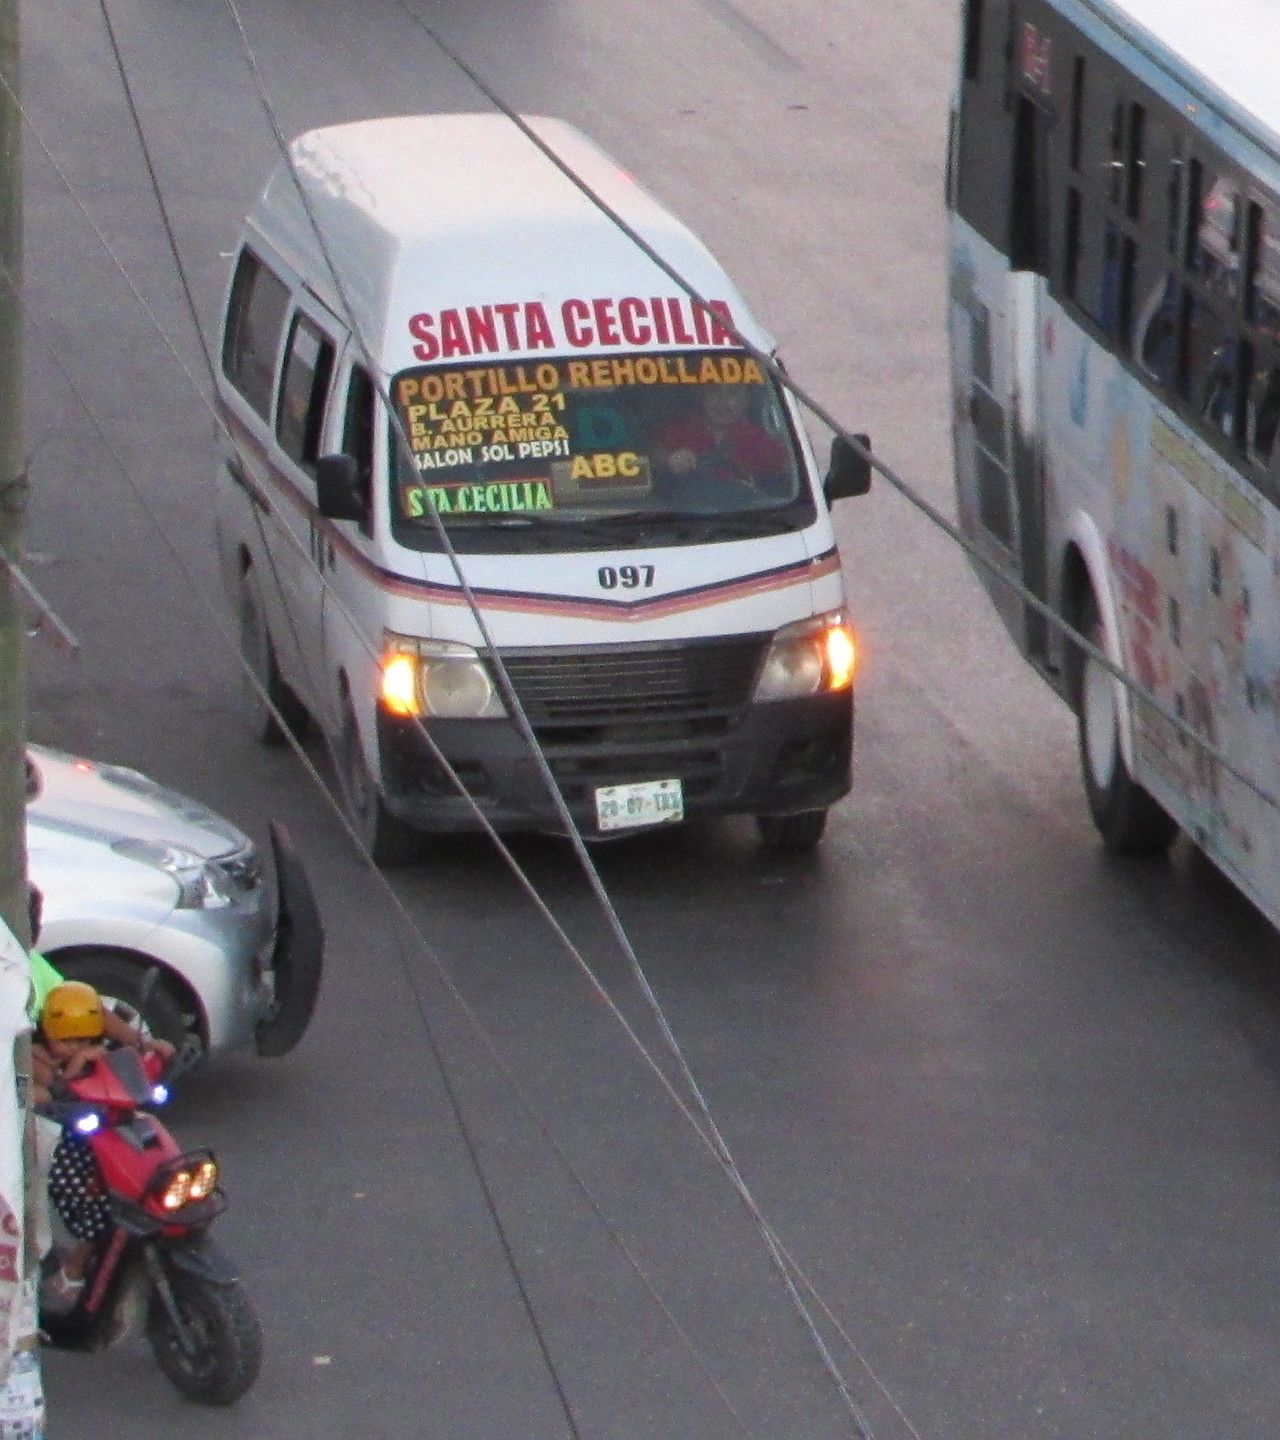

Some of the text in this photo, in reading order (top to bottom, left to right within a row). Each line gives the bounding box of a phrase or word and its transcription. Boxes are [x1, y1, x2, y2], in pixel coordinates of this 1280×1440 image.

[408, 296, 745, 362] SANTA CECILIA
[398, 357, 765, 407] PORTILLO REHOLLADA
[409, 392, 566, 424] PLAZA 21
[441, 411, 557, 433] AURRERA
[411, 425, 569, 451] MANO AMIGA
[481, 444, 516, 462] SOL
[518, 439, 571, 459] PEPSI
[570, 451, 640, 480] ABC
[598, 564, 655, 590] 097
